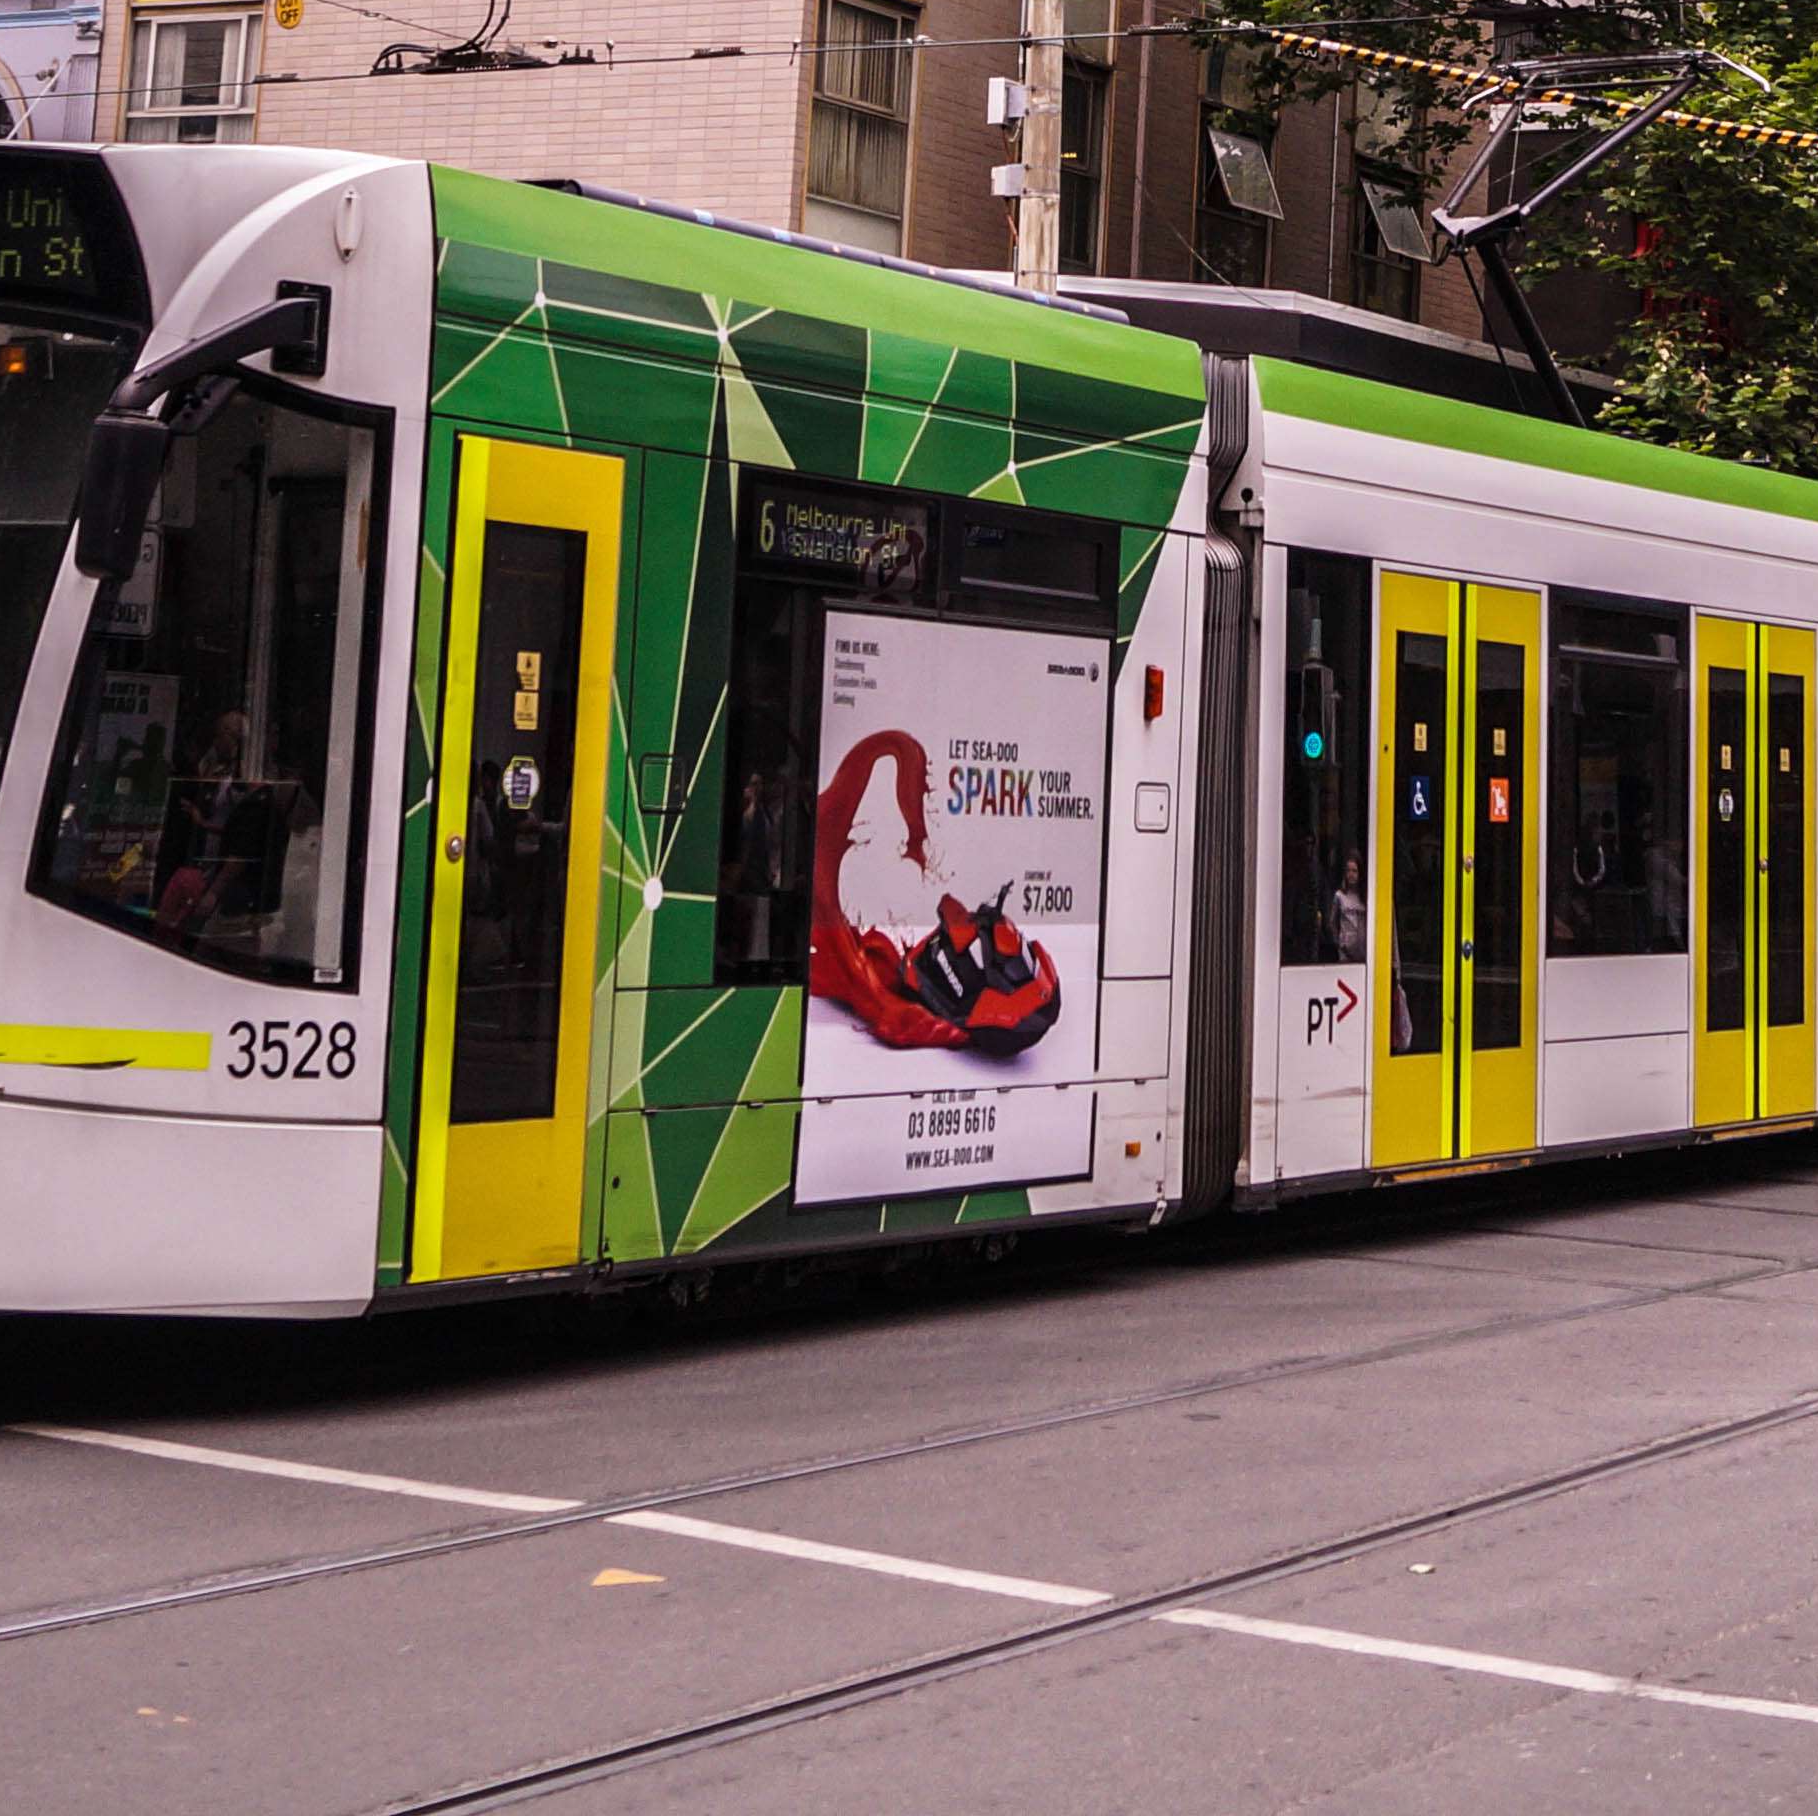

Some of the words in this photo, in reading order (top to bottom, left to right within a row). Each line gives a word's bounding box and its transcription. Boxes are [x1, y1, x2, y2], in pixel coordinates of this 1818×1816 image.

[281, 8, 298, 23] OFF
[8, 187, 64, 228] Uni
[45, 236, 83, 277] St
[760, 500, 775, 552] 6
[786, 504, 874, 536] Melbourne
[789, 532, 873, 566] Swanston
[949, 739, 968, 760] LET
[972, 740, 1018, 762] SEA-DOO
[948, 766, 1035, 817] SPARK
[1039, 770, 1070, 794] YOUR
[1038, 795, 1094, 820] SUMMER.
[1023, 885, 1072, 917] $7,800
[1307, 997, 1338, 1045] PT
[227, 1020, 357, 1079] 3528
[908, 1111, 924, 1139] 03
[929, 1109, 960, 1137] 8899
[965, 1106, 996, 1135] 6616
[906, 1145, 994, 1170] WWW.SEA-DOO.COM
